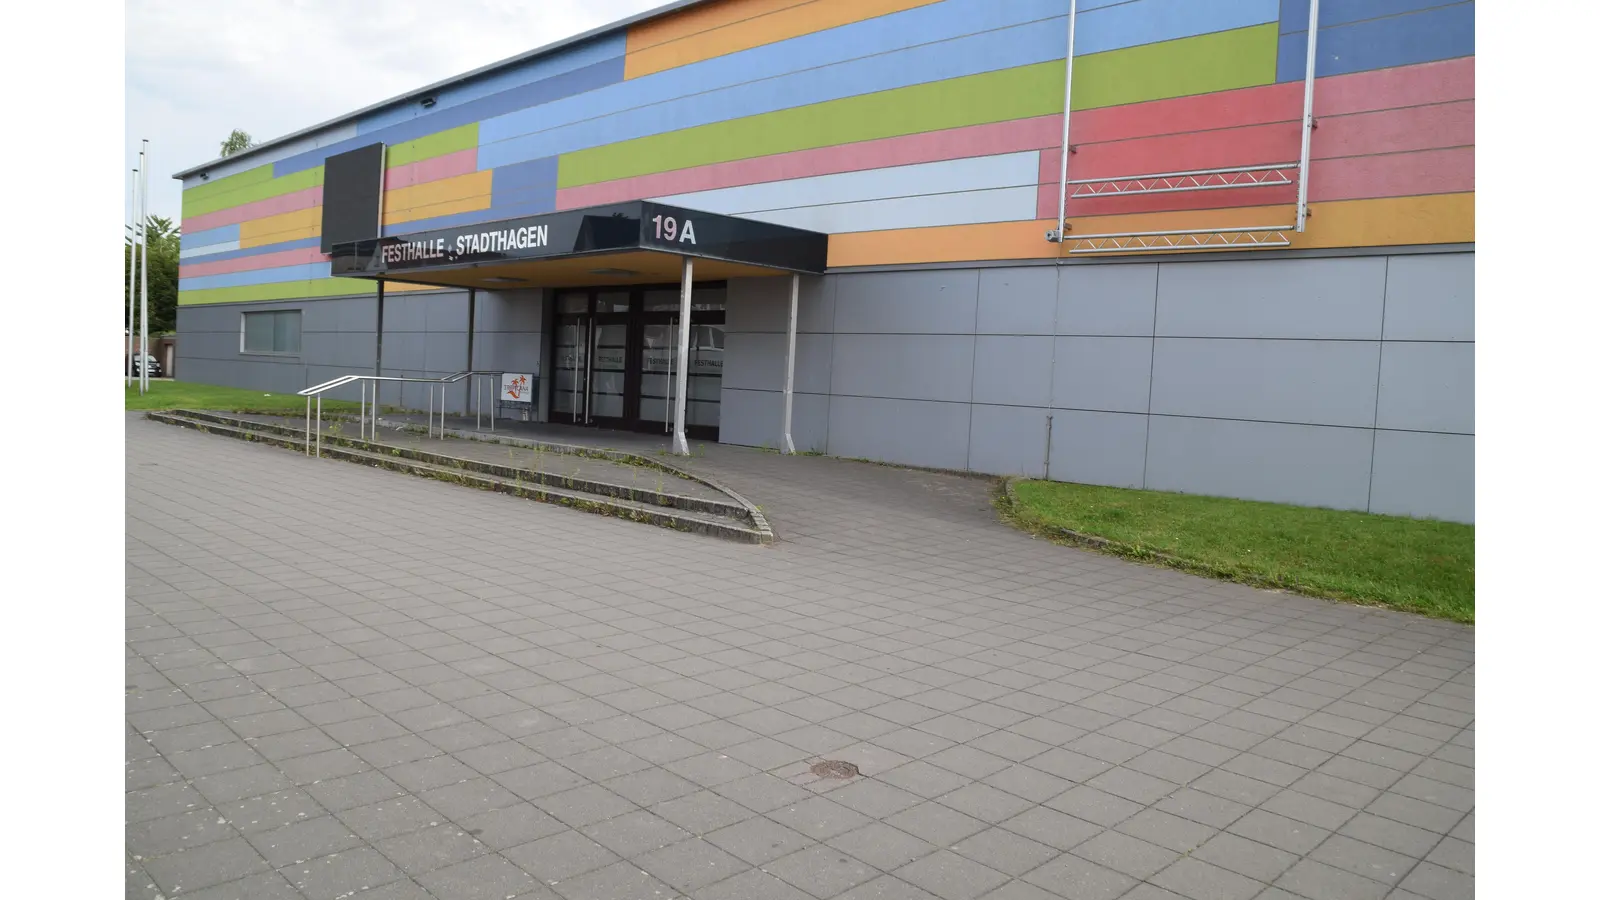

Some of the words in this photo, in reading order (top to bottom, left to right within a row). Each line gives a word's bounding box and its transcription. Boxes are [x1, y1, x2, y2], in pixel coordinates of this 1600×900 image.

[381, 238, 445, 264] FESTHALLE
[455, 224, 549, 256] STADTHAGEN
[694, 359, 724, 368] FESTHALLE
